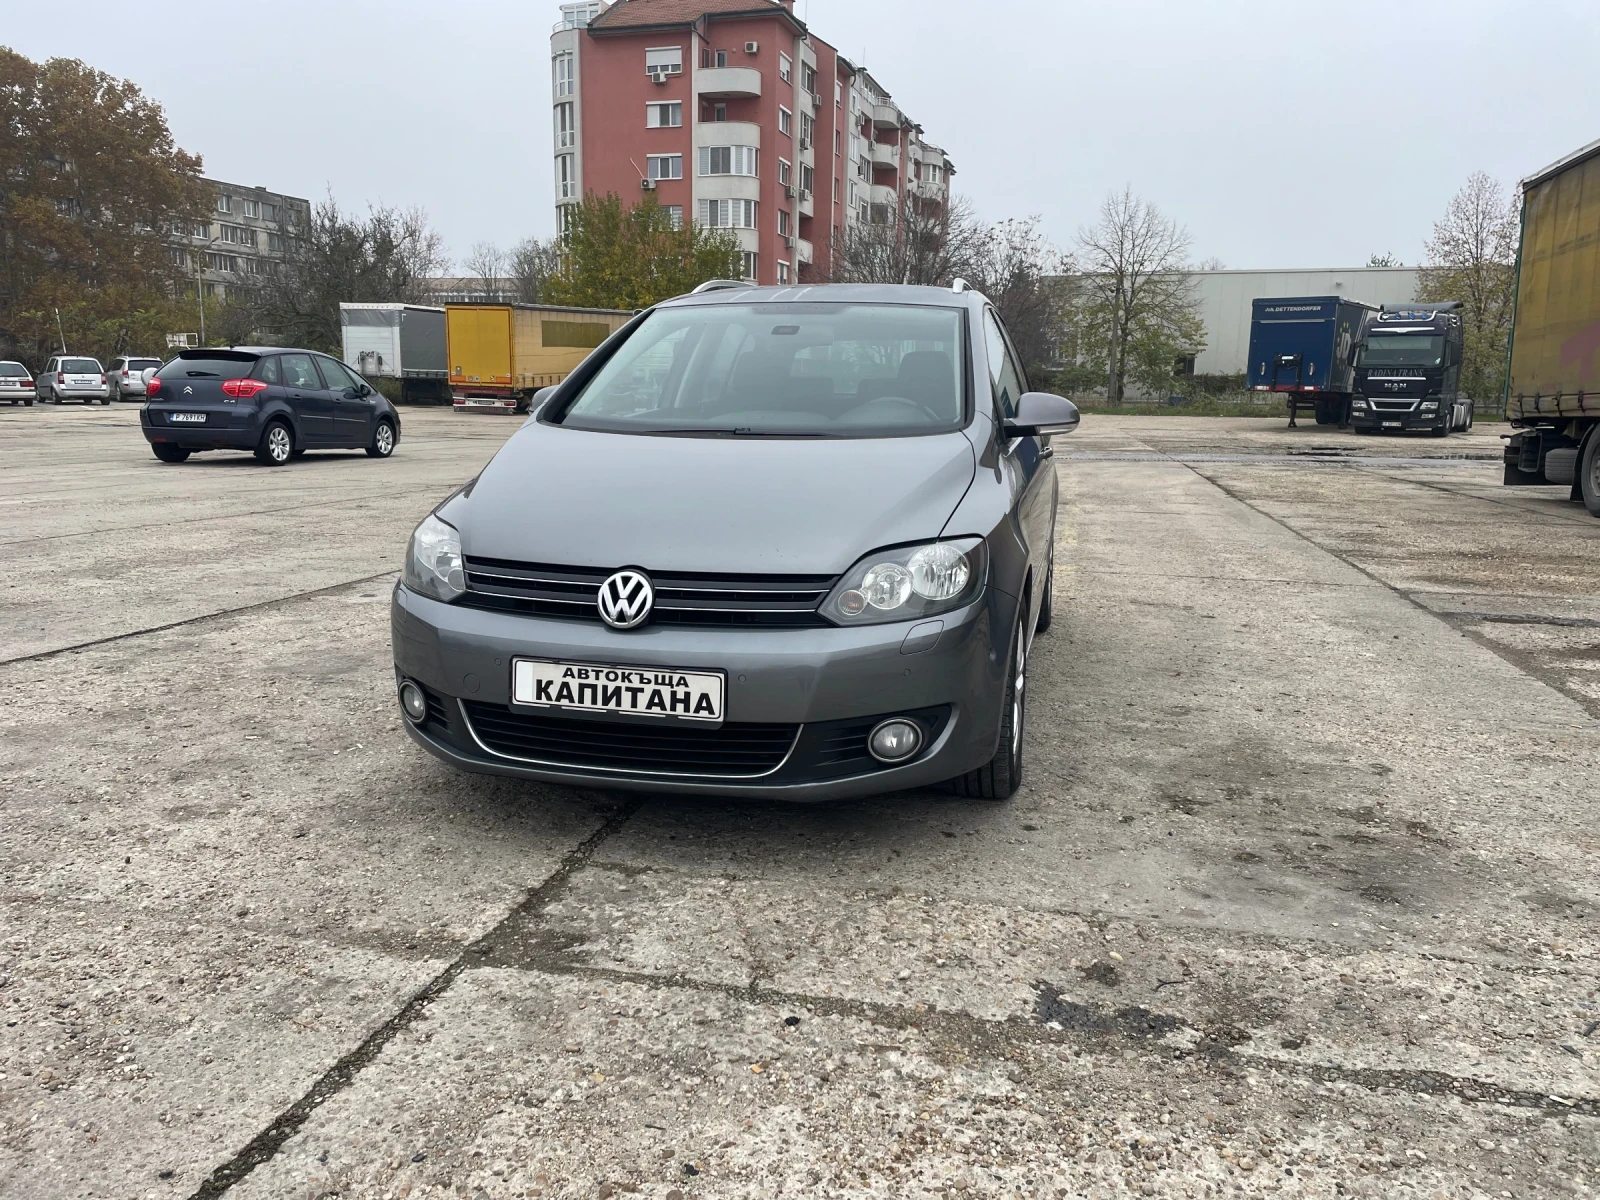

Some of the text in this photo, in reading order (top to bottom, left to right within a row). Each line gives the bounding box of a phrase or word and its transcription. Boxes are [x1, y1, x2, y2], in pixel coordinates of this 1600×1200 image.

[1367, 369, 1424, 377] RADINA TRANS
[562, 667, 690, 688] АВТОКЪЩА
[535, 679, 715, 715] КАПИТАНА
